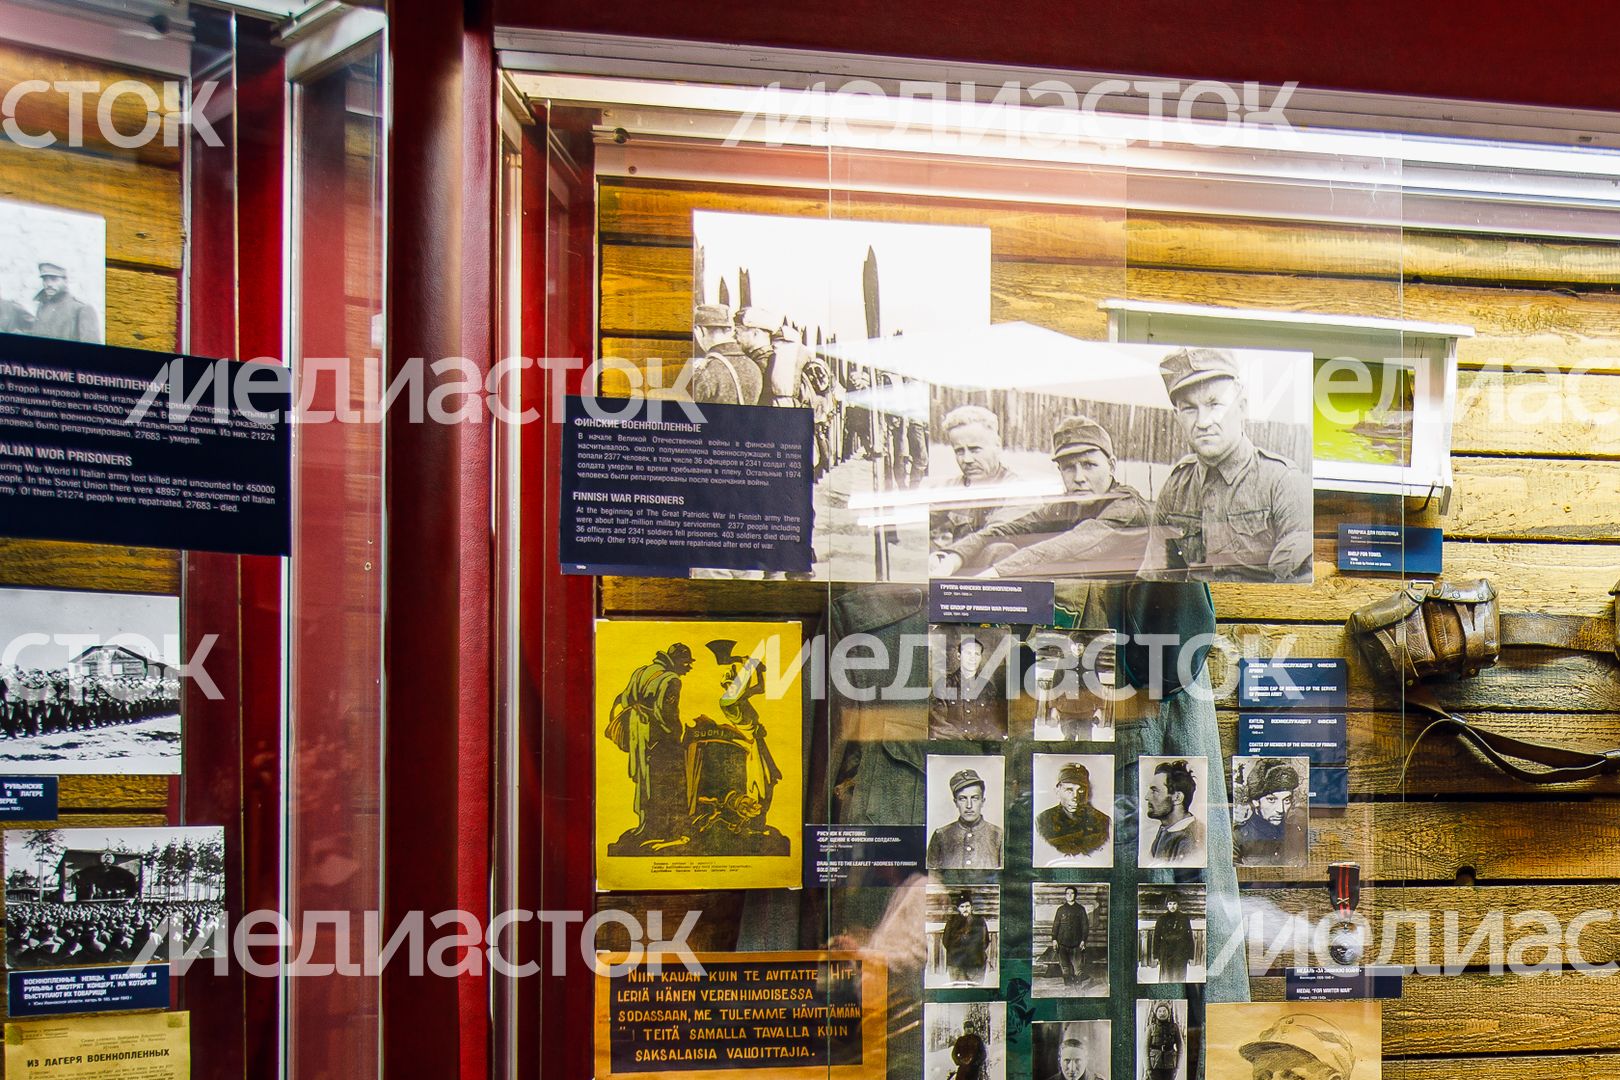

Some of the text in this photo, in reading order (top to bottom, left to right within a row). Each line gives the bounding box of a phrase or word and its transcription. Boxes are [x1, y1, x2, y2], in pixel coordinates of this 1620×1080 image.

[574, 418, 701, 433] ФИНСКИЕ ВОЕННОПЛЕННЫЕ
[36, 447, 65, 460] WOR
[67, 450, 133, 467] PRISONERS
[24, 464, 41, 473] War
[44, 466, 70, 476] World
[73, 468, 78, 477] II
[81, 469, 105, 479] Italian
[108, 473, 129, 482] army
[131, 473, 147, 483] lost
[149, 475, 170, 485] killed
[172, 478, 187, 486] and
[190, 480, 231, 490] uncounted
[233, 483, 244, 491] for
[246, 484, 275, 494] 450000
[573, 491, 685, 505] FINNISH WAR PRISONERS
[586, 506, 598, 514] the
[601, 507, 633, 517] beginning
[647, 509, 659, 517] The
[662, 509, 679, 517] Great
[682, 511, 710, 519] Patriotic
[713, 512, 726, 520] War
[729, 512, 735, 520] in
[739, 513, 761, 521] Finnish
[764, 515, 781, 523] army
[784, 515, 801, 523] there
[628, 967, 654, 983] NIIN
[661, 970, 700, 983] KAUAN
[709, 970, 738, 982] KUIN
[744, 970, 760, 982] TE
[766, 969, 818, 981] AVITATTE
[618, 986, 813, 1002] LERIÄ HÄNEN VERENHIMOISESSA
[618, 1009, 691, 1023] SODASSAAN,
[694, 1008, 712, 1021] ME
[719, 1008, 787, 1021] TULEMME
[643, 1025, 848, 1041] TEITÄ SAMALLA TAVALLA KUIN
[27, 1048, 170, 1068] ИЗ ЛАГЕРЯ ВОЕННОПЛЕННЫХ
[635, 1048, 717, 1062] SAKSALAISIA
